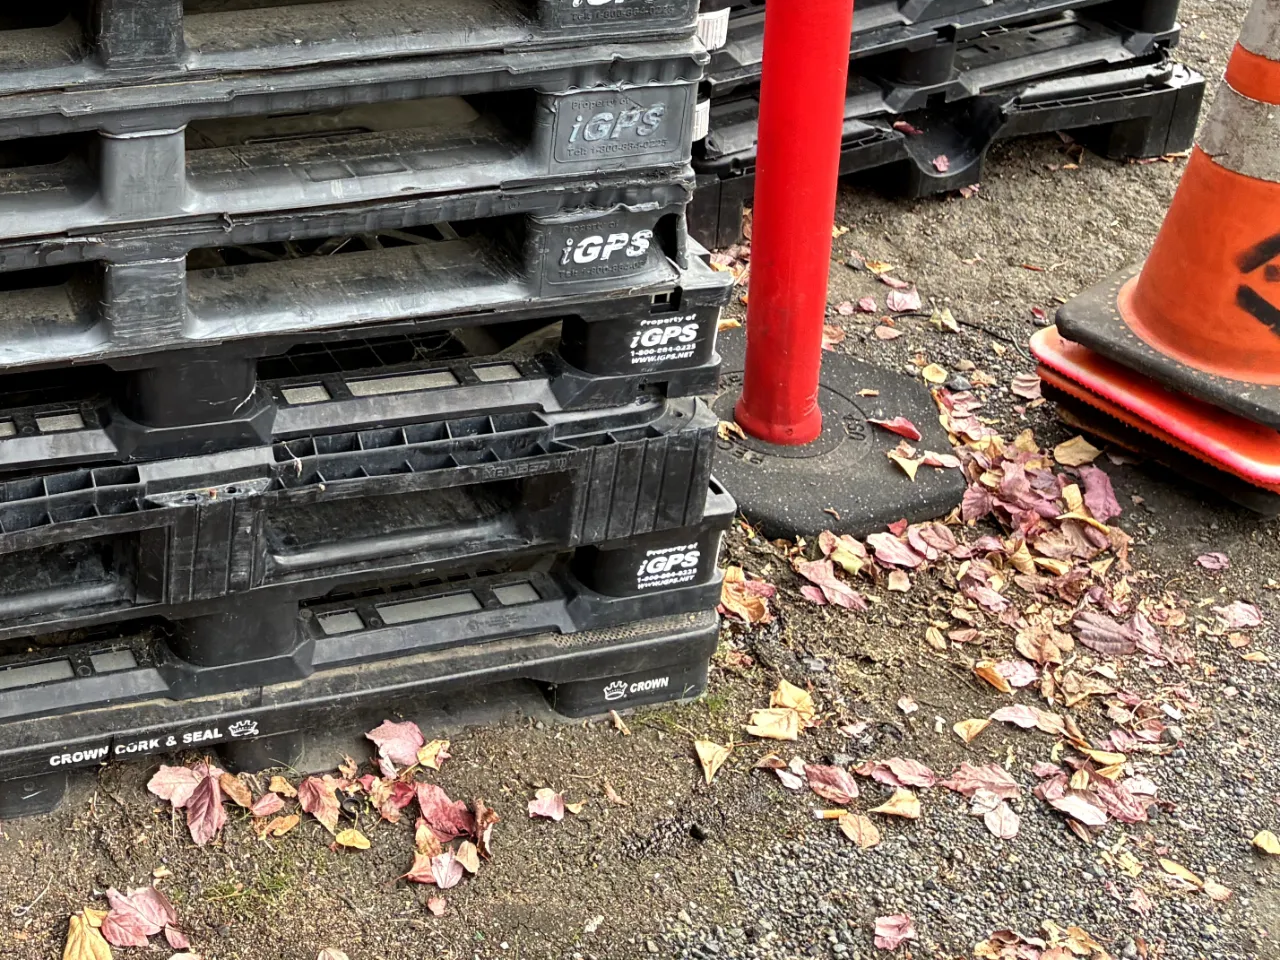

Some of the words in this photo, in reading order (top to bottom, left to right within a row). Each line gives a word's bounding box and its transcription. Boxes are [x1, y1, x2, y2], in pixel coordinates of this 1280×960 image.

[571, 99, 618, 110] Property
[569, 102, 666, 143] iGPS
[561, 229, 654, 266] iGPS
[640, 316, 684, 327] Property
[685, 313, 697, 321] of
[629, 323, 700, 349] iGPS
[631, 350, 695, 364] WWW.IGPS.NET
[646, 545, 687, 557] Property
[687, 542, 699, 550] of
[636, 550, 701, 576] iGPS
[629, 676, 669, 693] CROWN
[49, 745, 109, 766] CROWN
[114, 738, 160, 756] CORK
[165, 735, 177, 747] &
[182, 727, 223, 744] SEAL
